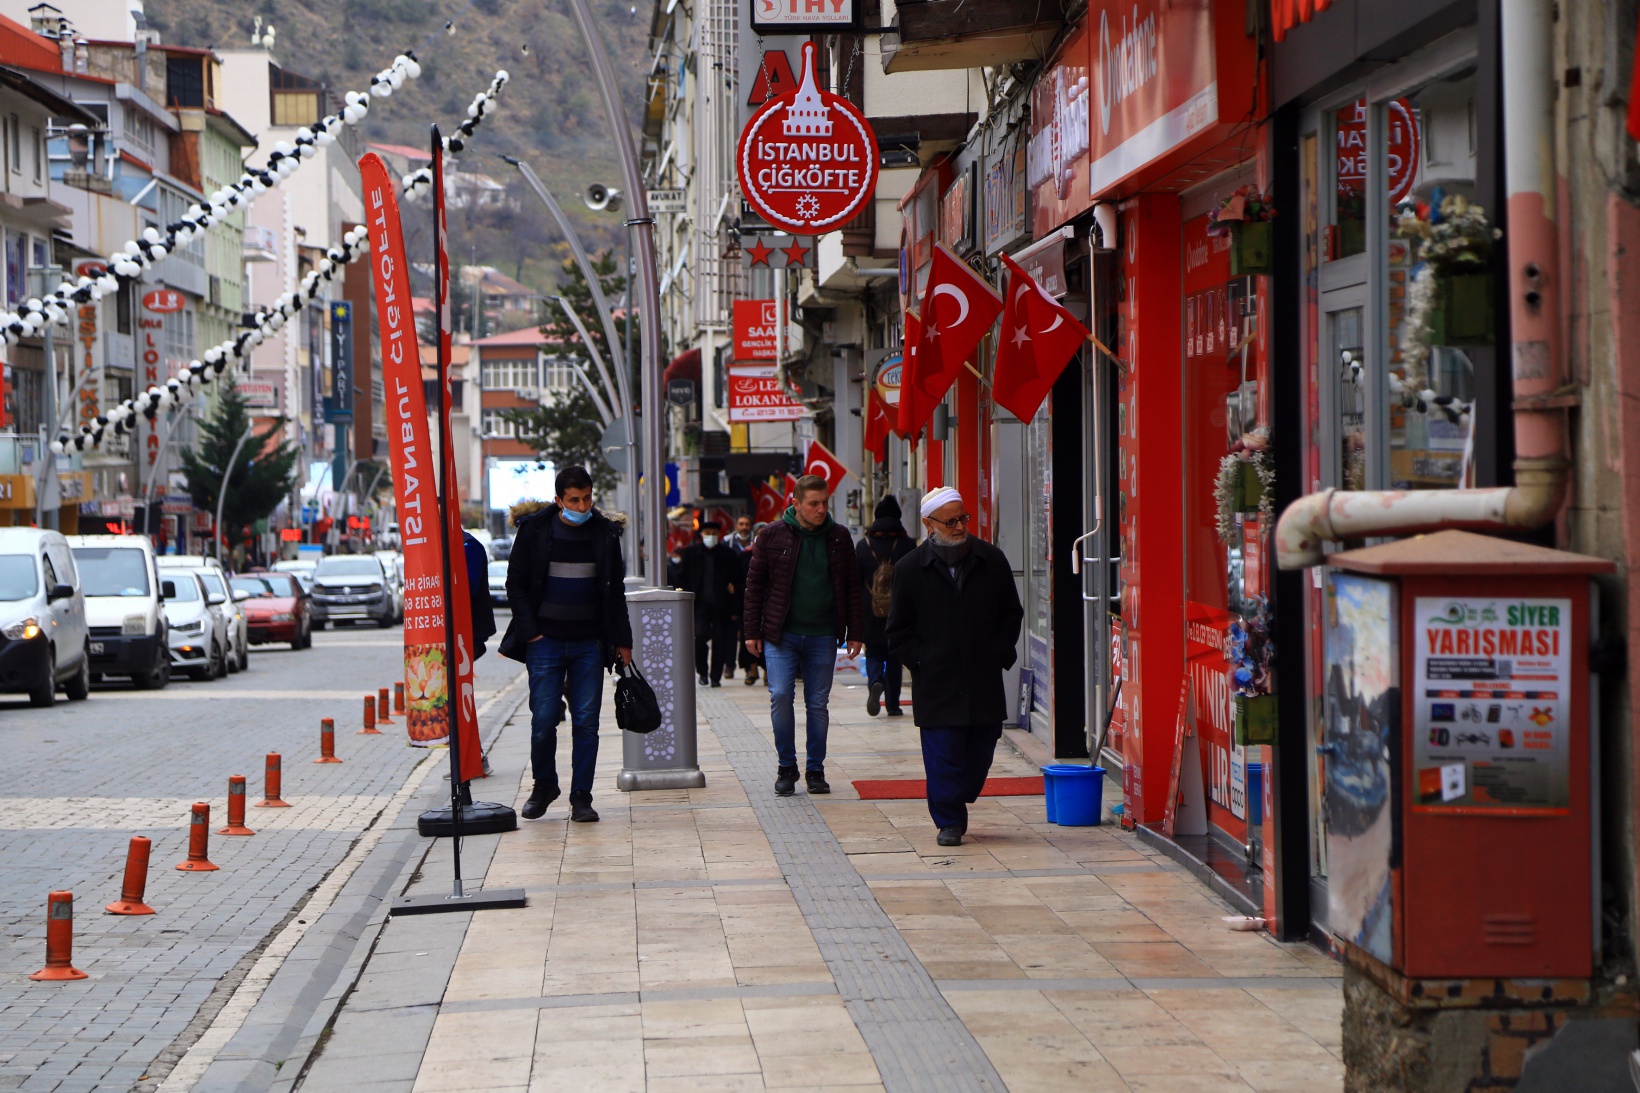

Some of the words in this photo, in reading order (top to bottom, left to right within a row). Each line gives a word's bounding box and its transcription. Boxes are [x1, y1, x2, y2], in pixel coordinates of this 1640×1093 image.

[788, 0, 847, 13] THY
[757, 136, 860, 162] İSTANBUL
[758, 164, 860, 191] ÇİĞKÖFTE
[651, 192, 682, 201] AVUKAT
[1507, 602, 1560, 627] SİYER
[1426, 628, 1560, 660] YARIŞMASI
